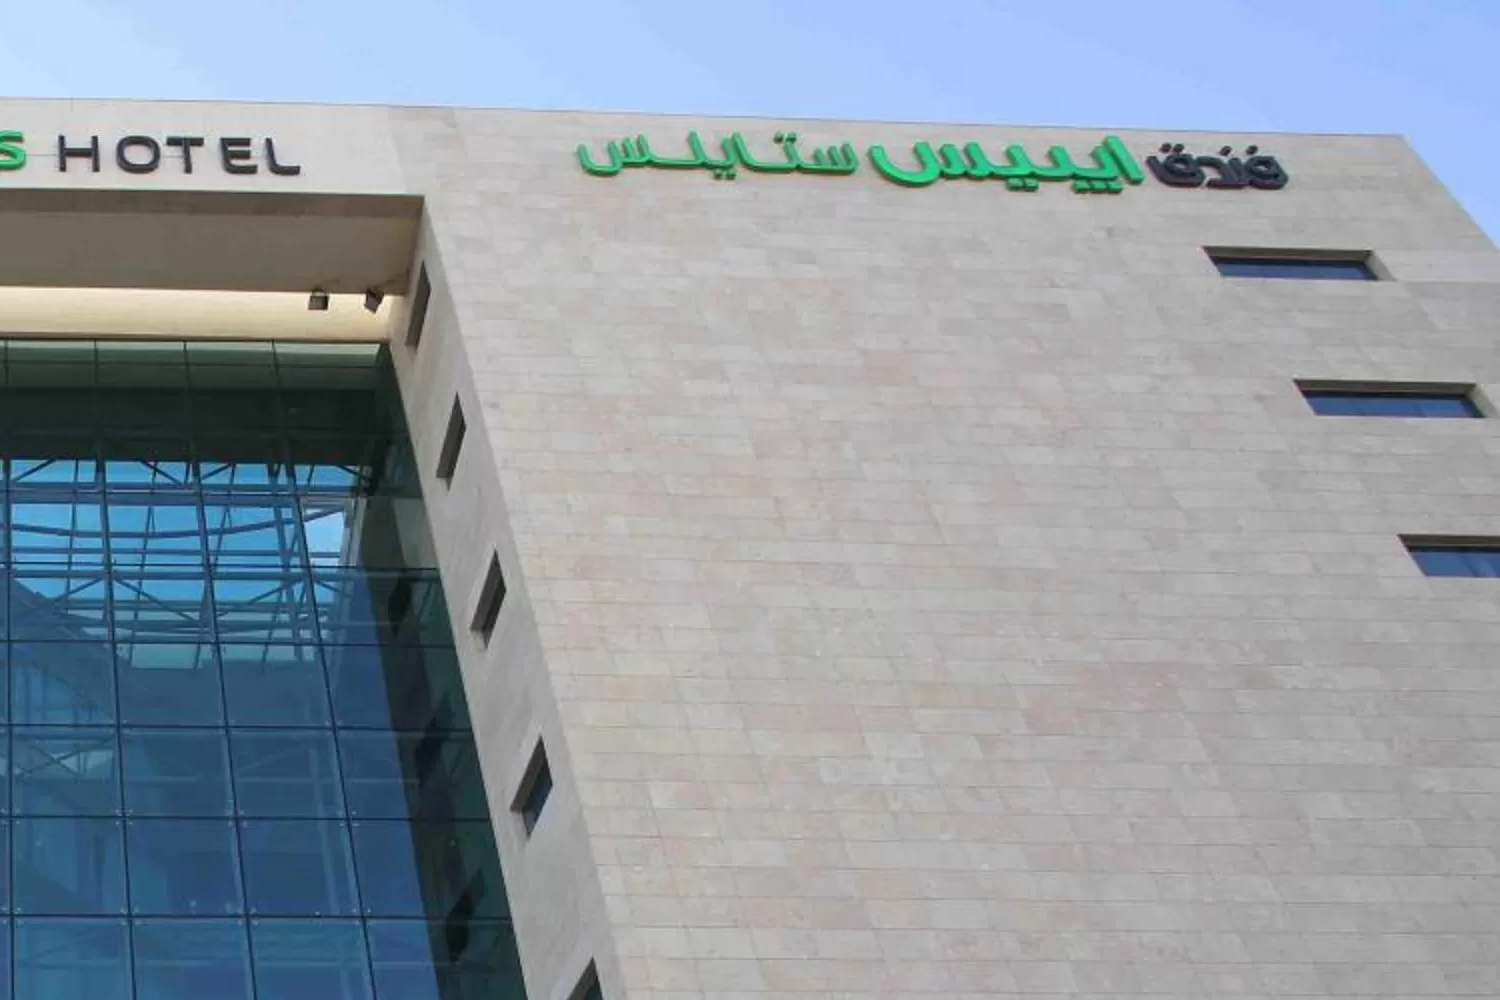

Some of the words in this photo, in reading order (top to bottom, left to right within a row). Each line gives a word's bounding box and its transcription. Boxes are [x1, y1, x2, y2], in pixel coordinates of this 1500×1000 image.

[58, 135, 302, 176] HOTEL
[577, 129, 859, 181] ستايلس
[1146, 143, 1290, 190] فندق
